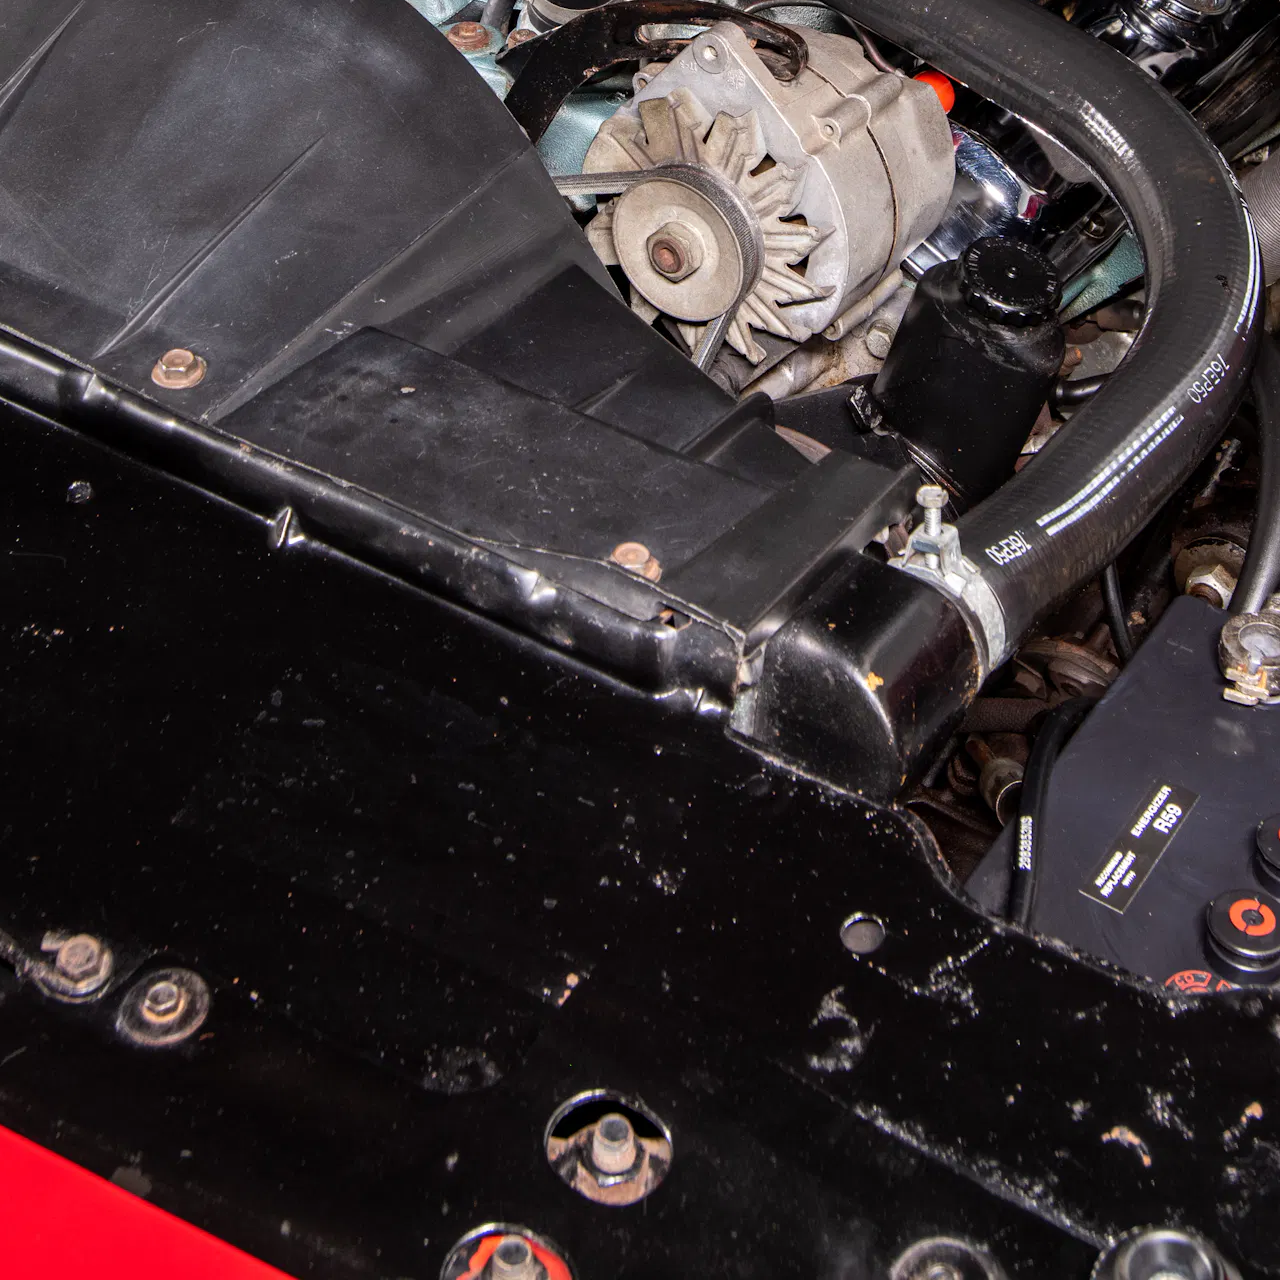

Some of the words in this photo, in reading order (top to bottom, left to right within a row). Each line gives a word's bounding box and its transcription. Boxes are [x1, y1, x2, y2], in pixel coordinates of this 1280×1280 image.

[1187, 353, 1230, 404] 76EP50
[984, 531, 1032, 566] 76EP50
[1130, 785, 1172, 838] ENERGIZER
[1153, 803, 1183, 835] R59
[1100, 850, 1136, 898] REPLACEMENT
[1121, 870, 1136, 888] WITH
